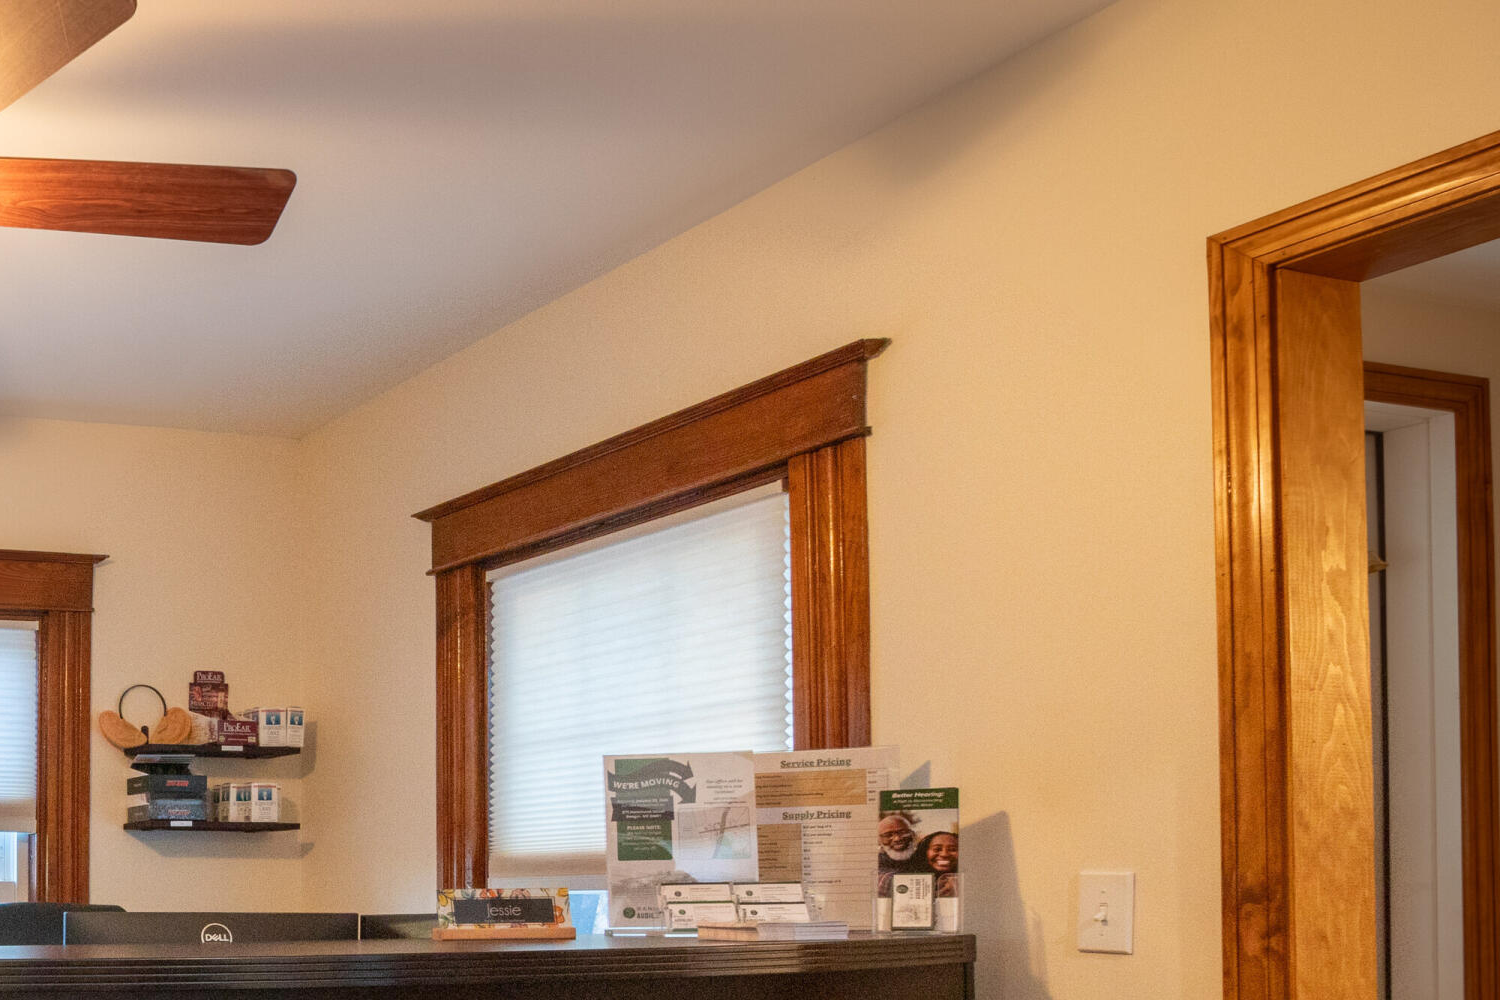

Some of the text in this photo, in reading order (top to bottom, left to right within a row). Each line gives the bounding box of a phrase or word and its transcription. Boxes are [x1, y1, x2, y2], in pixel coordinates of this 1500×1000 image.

[780, 757, 852, 769] Service Pricing
[640, 778, 680, 788] MOVING
[782, 809, 852, 821] Supply Pricing
[486, 903, 522, 918] Jessie
[205, 933, 230, 942] DELL
